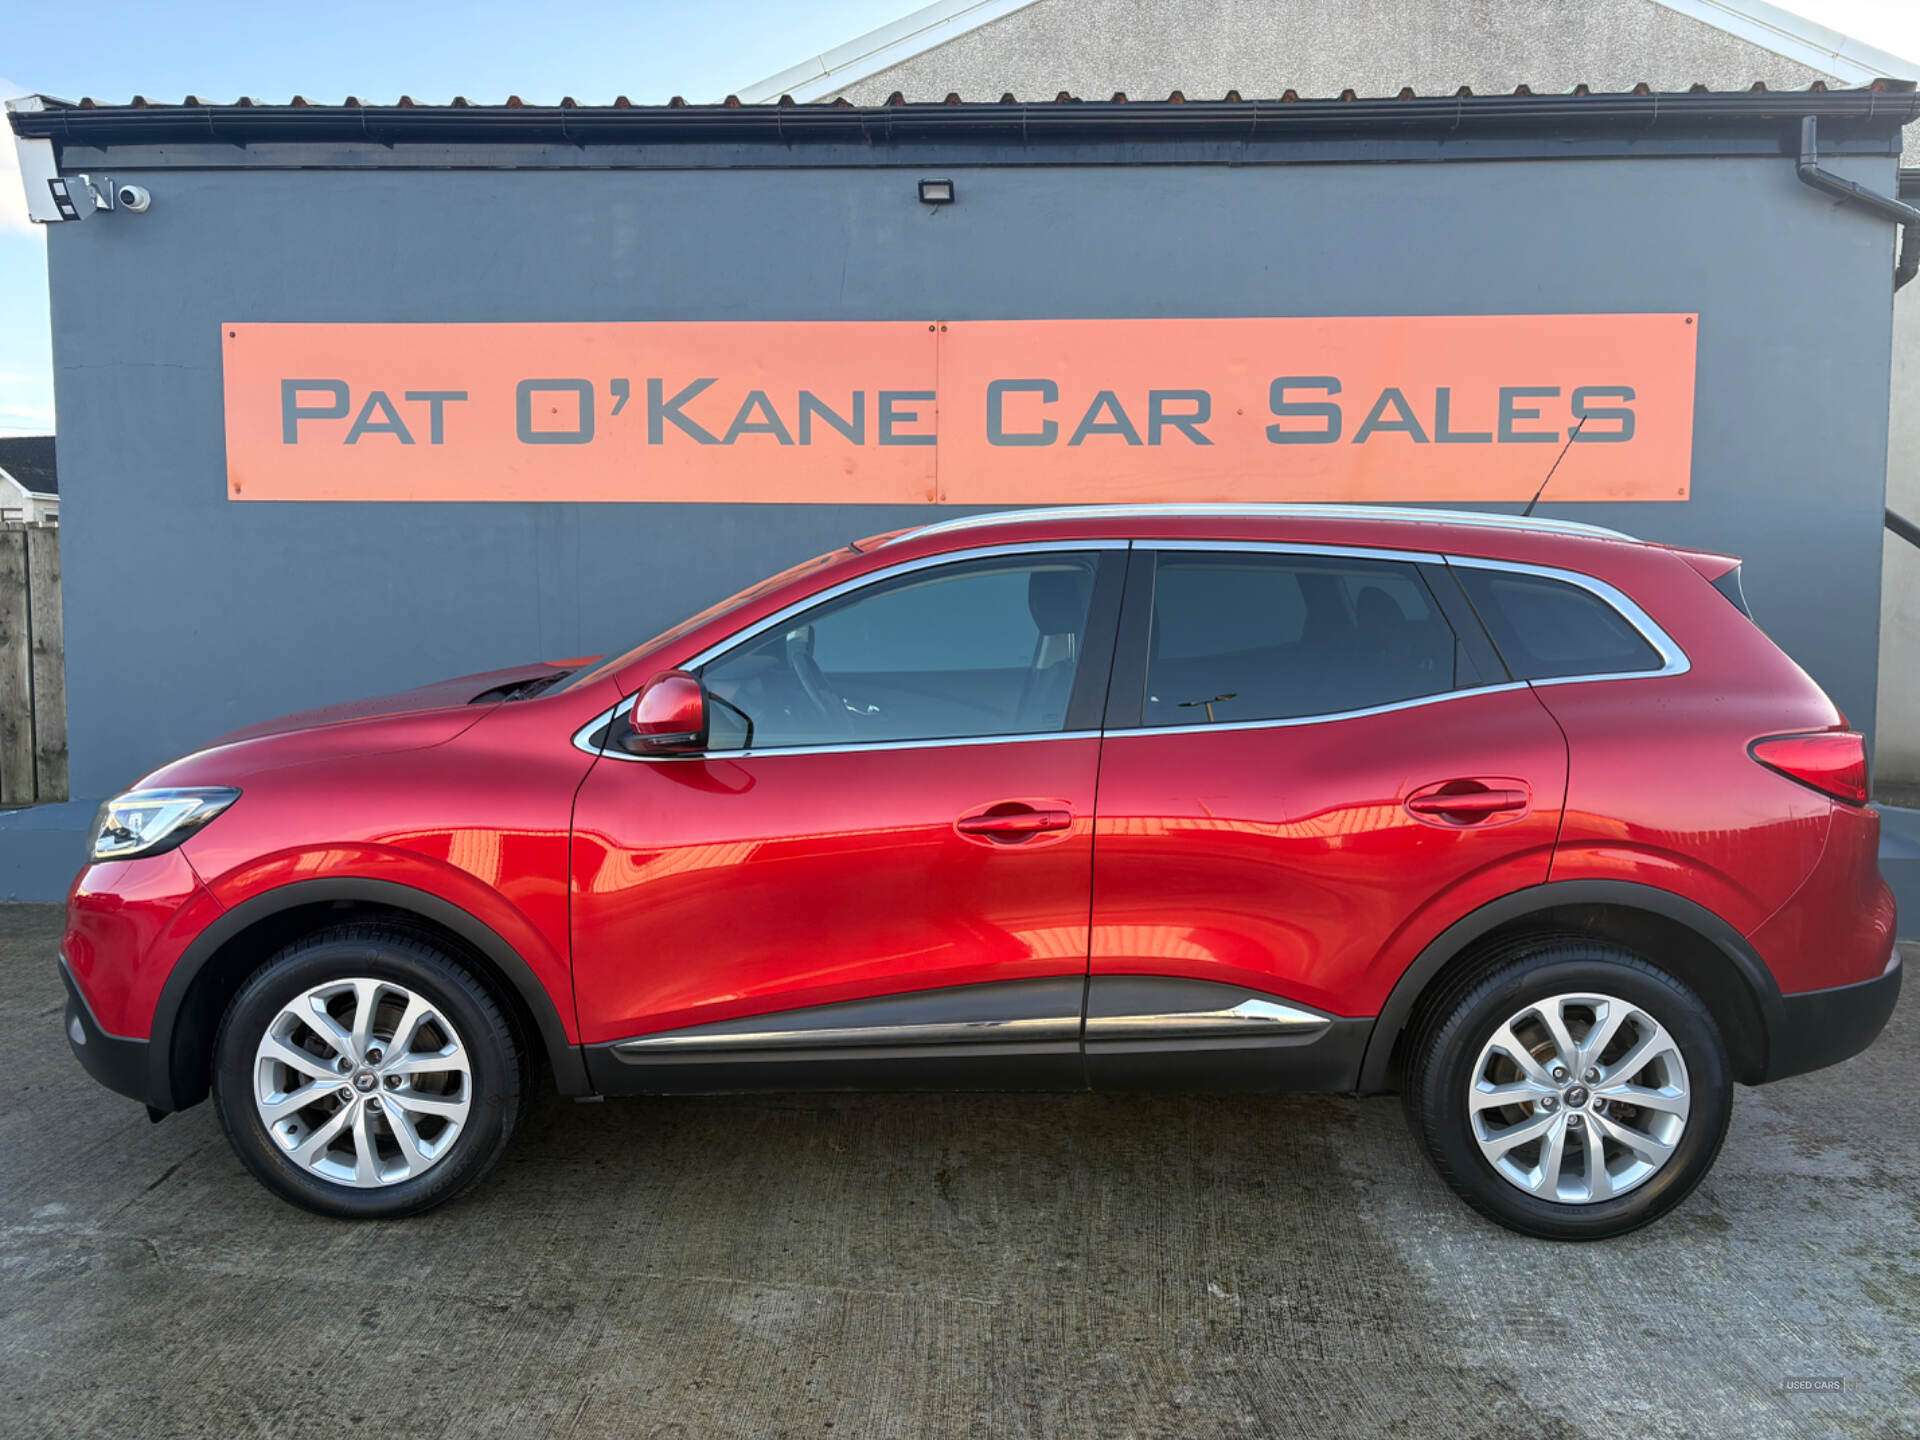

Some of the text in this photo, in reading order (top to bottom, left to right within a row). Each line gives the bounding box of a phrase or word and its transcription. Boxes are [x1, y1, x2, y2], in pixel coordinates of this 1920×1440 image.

[280, 375, 1637, 447] PAT O'KANE CAR SALES
